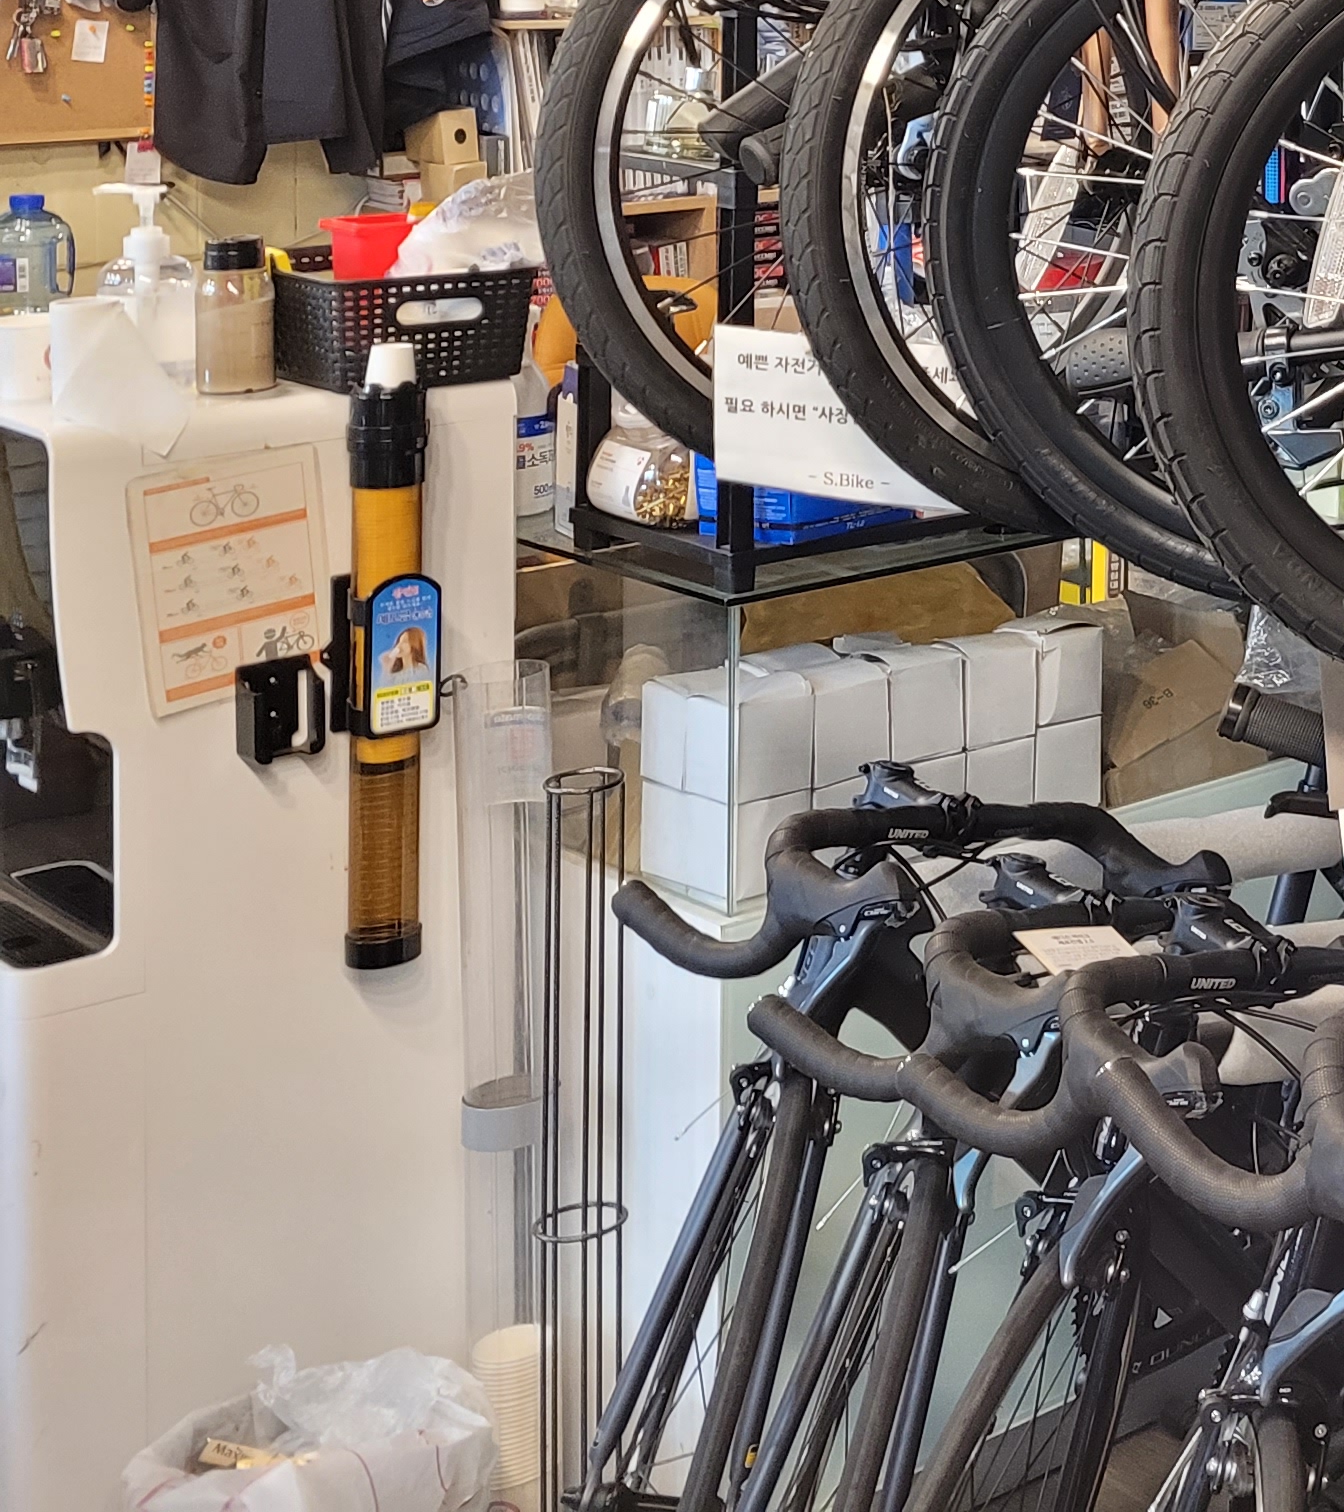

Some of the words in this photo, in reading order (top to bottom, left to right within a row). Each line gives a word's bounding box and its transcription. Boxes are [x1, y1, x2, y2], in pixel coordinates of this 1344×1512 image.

[737, 352, 769, 371] 예쁜
[724, 396, 755, 414] 필요
[760, 401, 807, 421] 하시면
[823, 472, 874, 490] S.Bike
[888, 828, 929, 840] UNITED
[1190, 977, 1237, 990] UNITED
